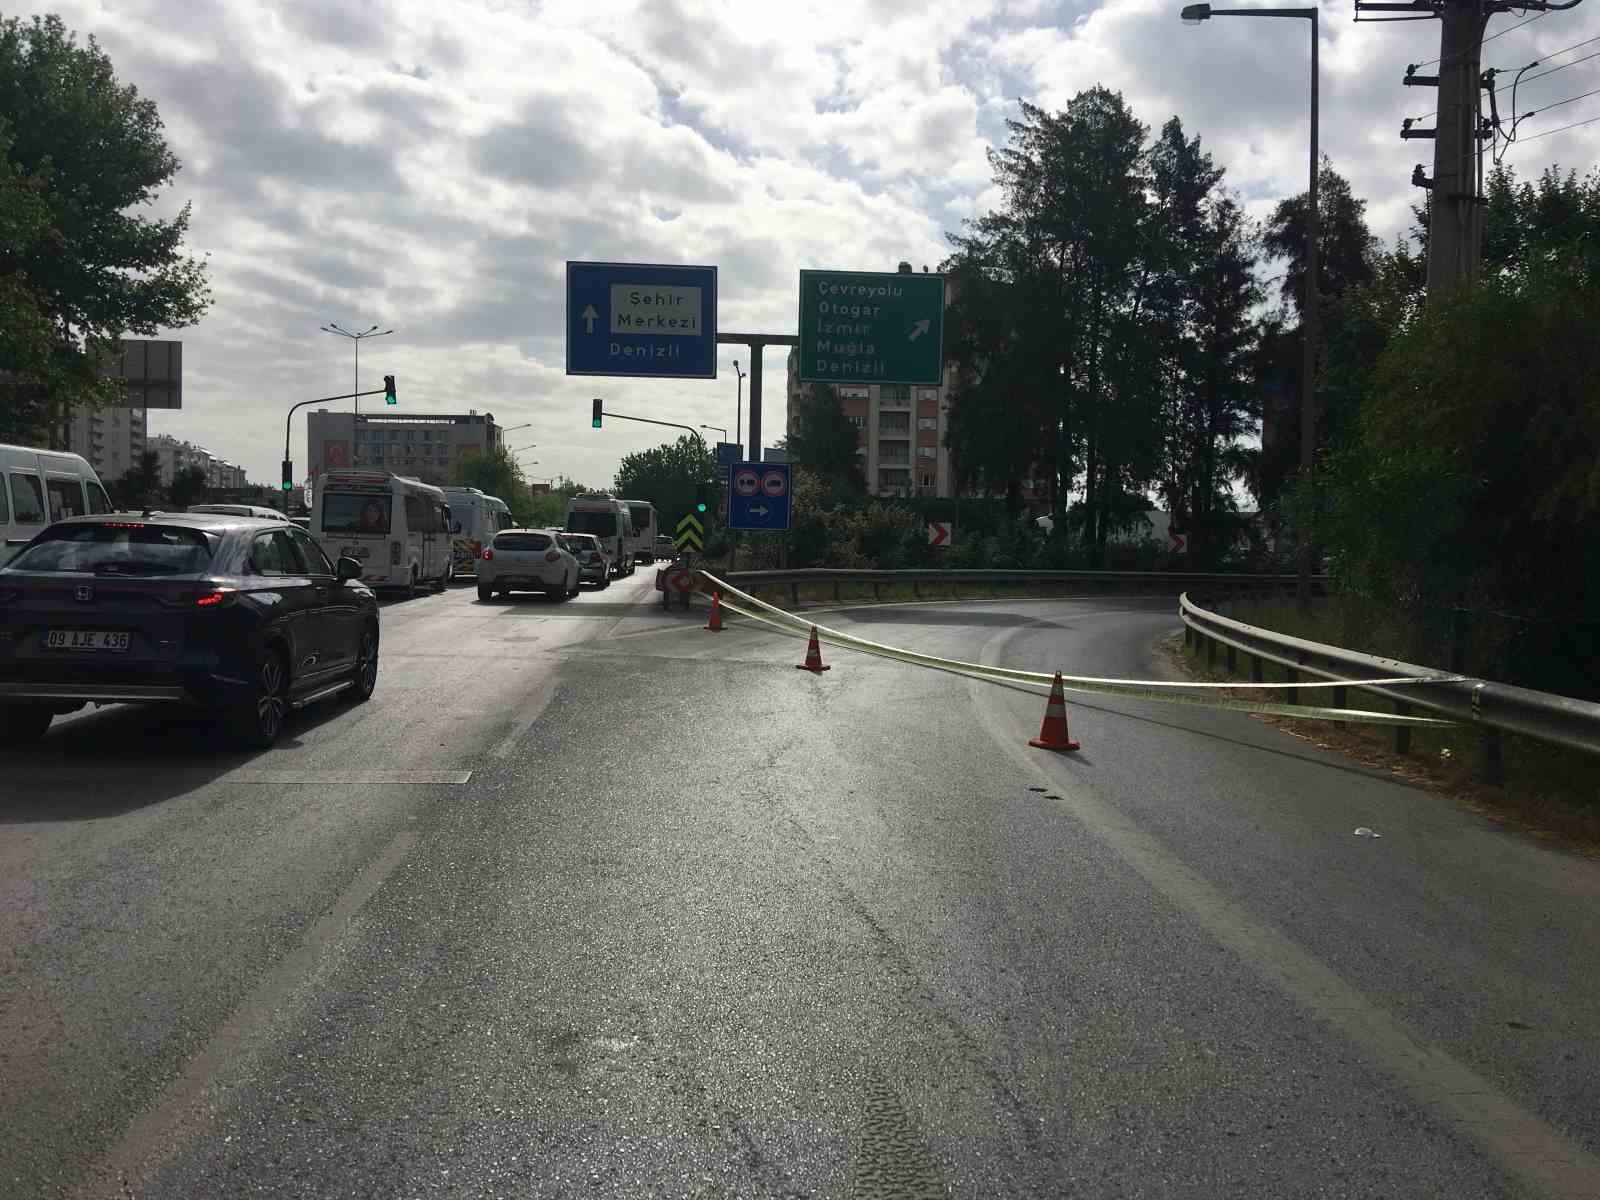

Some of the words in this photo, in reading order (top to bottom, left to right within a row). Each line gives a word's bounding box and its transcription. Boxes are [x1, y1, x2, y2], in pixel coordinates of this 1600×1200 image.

[818, 280, 904, 299] Çevreyolu
[629, 291, 684, 308] Şehir
[818, 301, 881, 319] Otogar
[617, 312, 696, 328] Merkezi
[609, 342, 680, 357] Denizli
[816, 339, 876, 357] Muğla
[816, 360, 887, 376] Denizli
[49, 631, 66, 646] 09
[72, 631, 96, 646] AJE
[103, 631, 128, 647] 436
